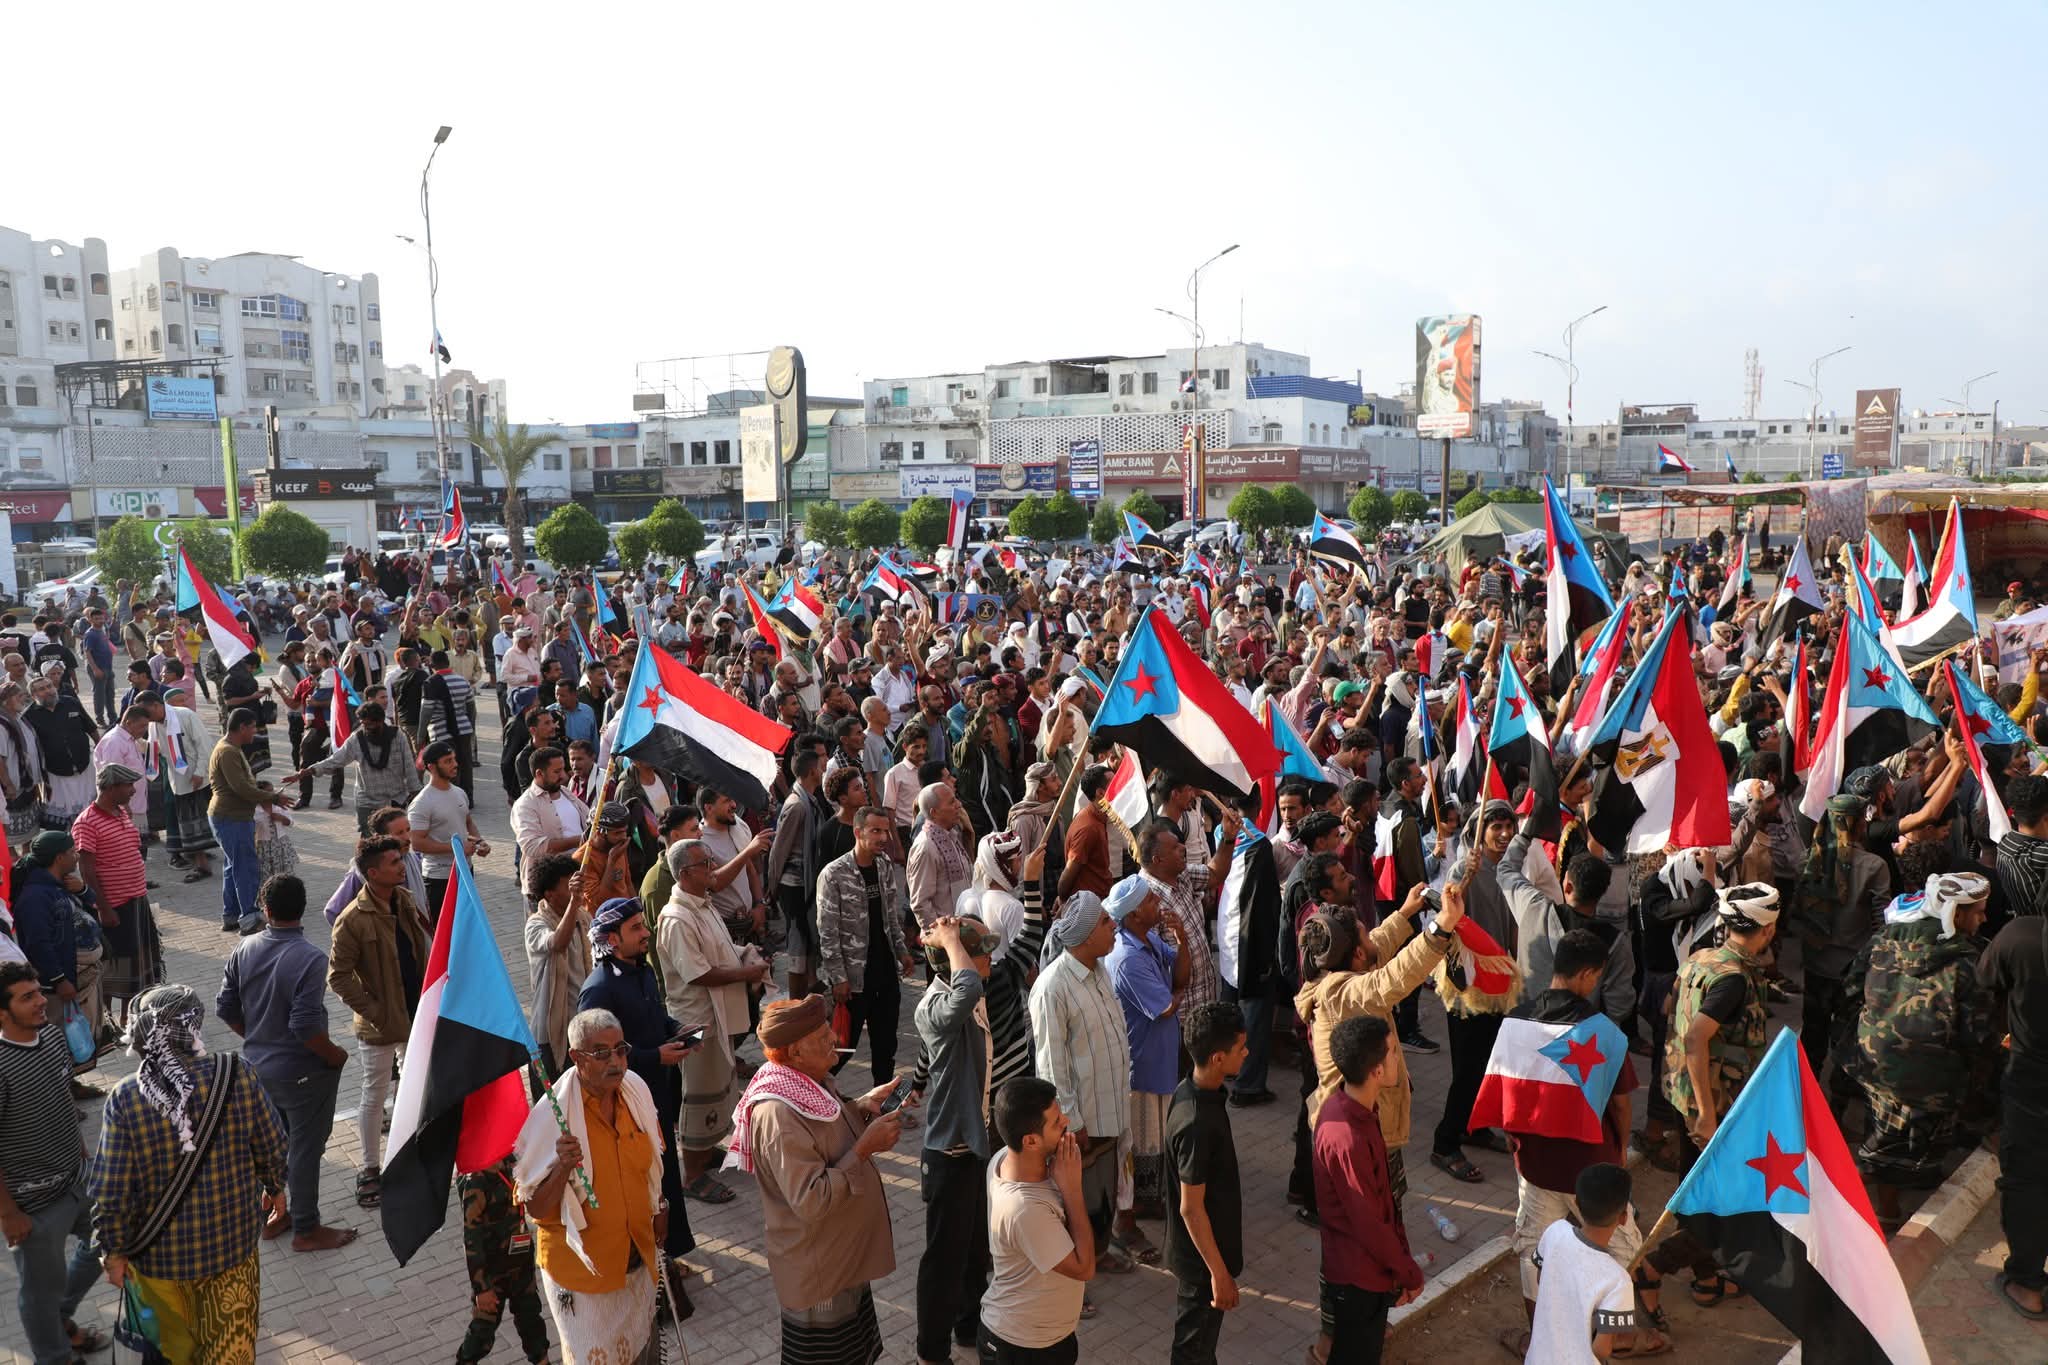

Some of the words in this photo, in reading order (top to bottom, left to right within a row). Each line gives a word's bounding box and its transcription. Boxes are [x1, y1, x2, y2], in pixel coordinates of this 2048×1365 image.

[1104, 457, 1127, 467] AMIC
[1128, 457, 1154, 467] BANK
[1205, 455, 1229, 467] الإسلا
[1230, 455, 1258, 466] عدن
[1258, 452, 1285, 465] بنك
[910, 474, 939, 487] للتجارة
[943, 474, 972, 487] باعبيد
[275, 483, 309, 493] KEEF
[11, 502, 39, 515] ket
[1599, 1314, 1634, 1327] TERN
